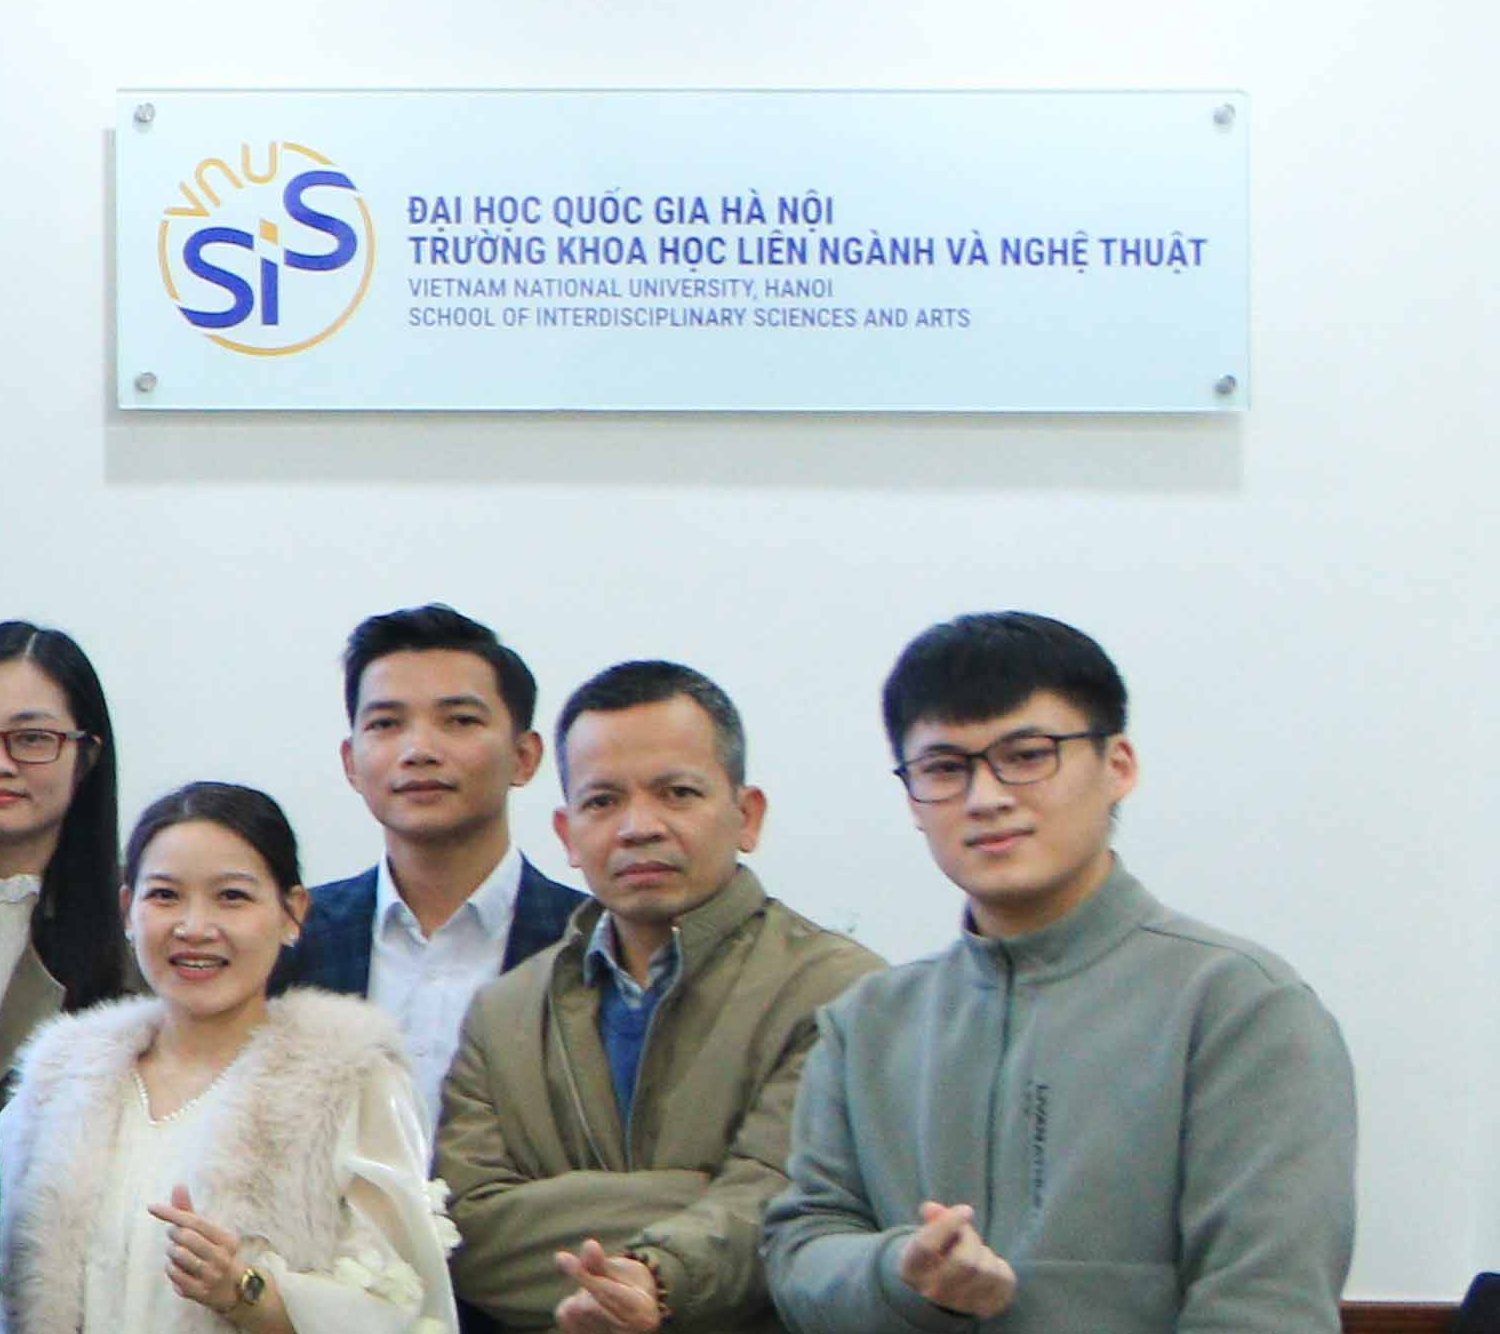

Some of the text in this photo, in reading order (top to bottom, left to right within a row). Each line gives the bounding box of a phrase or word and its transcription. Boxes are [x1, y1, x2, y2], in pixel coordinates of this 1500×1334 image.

[407, 187, 834, 232] ĐẠI HỌC QUỐC GIA HÀ NỘI
[177, 169, 358, 330] SiS
[408, 229, 1208, 274] TRƯỜNG KHOA HỌC LIÊN NGÀNH VÀ NGHỆ THUẬT
[408, 278, 834, 300] VIETNAM NATIONAL UNIVERSITY, HANOI
[409, 307, 971, 328] SCHOOL OF INTERDISCIPLINARY SCIENCES AND ARTS
